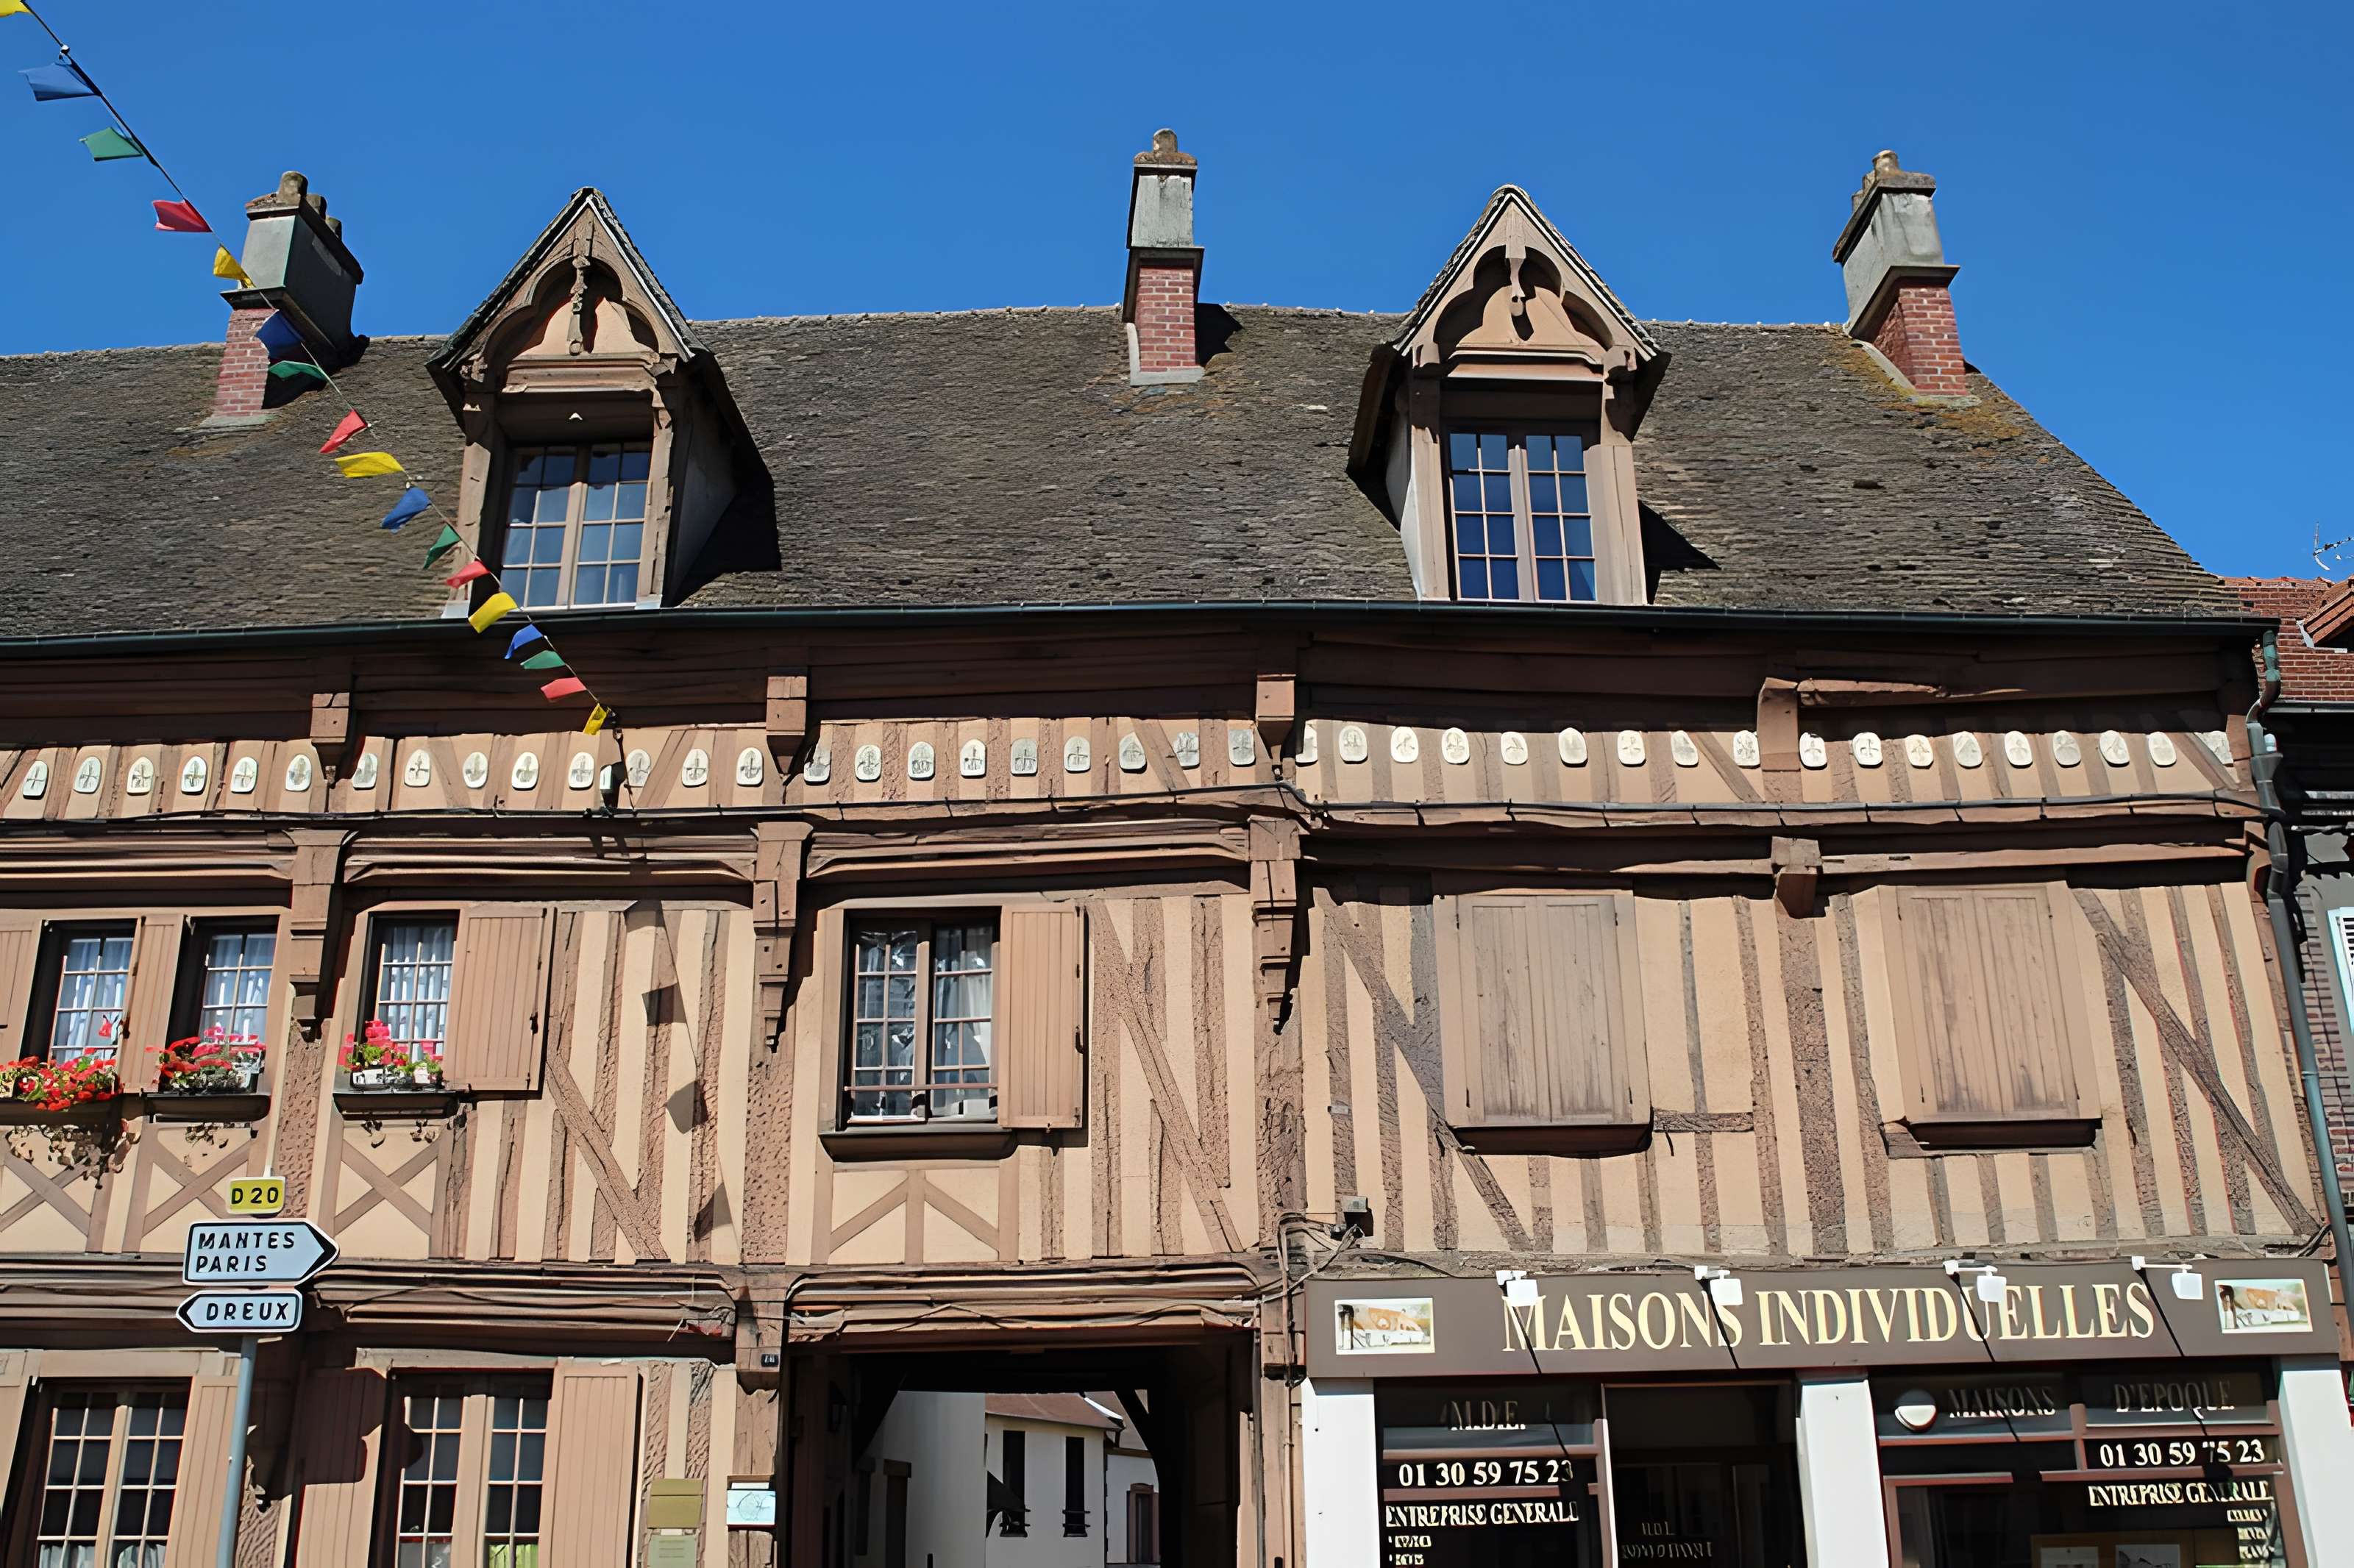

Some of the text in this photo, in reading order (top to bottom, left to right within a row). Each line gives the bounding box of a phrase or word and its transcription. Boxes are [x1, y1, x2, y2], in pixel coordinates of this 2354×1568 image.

[231, 1186, 279, 1205] D 20
[197, 1231, 296, 1250] MANTES
[196, 1255, 267, 1273] PARIS
[205, 1302, 290, 1322] DREUX
[1501, 1282, 2155, 1352] MAISONS INDIVIDUELLES
[2099, 1439, 2266, 1467] 01 30 59 75 23
[1398, 1459, 1574, 1487] 01 30 59 75 23
[1385, 1503, 1487, 1528] ENTREPRISE
